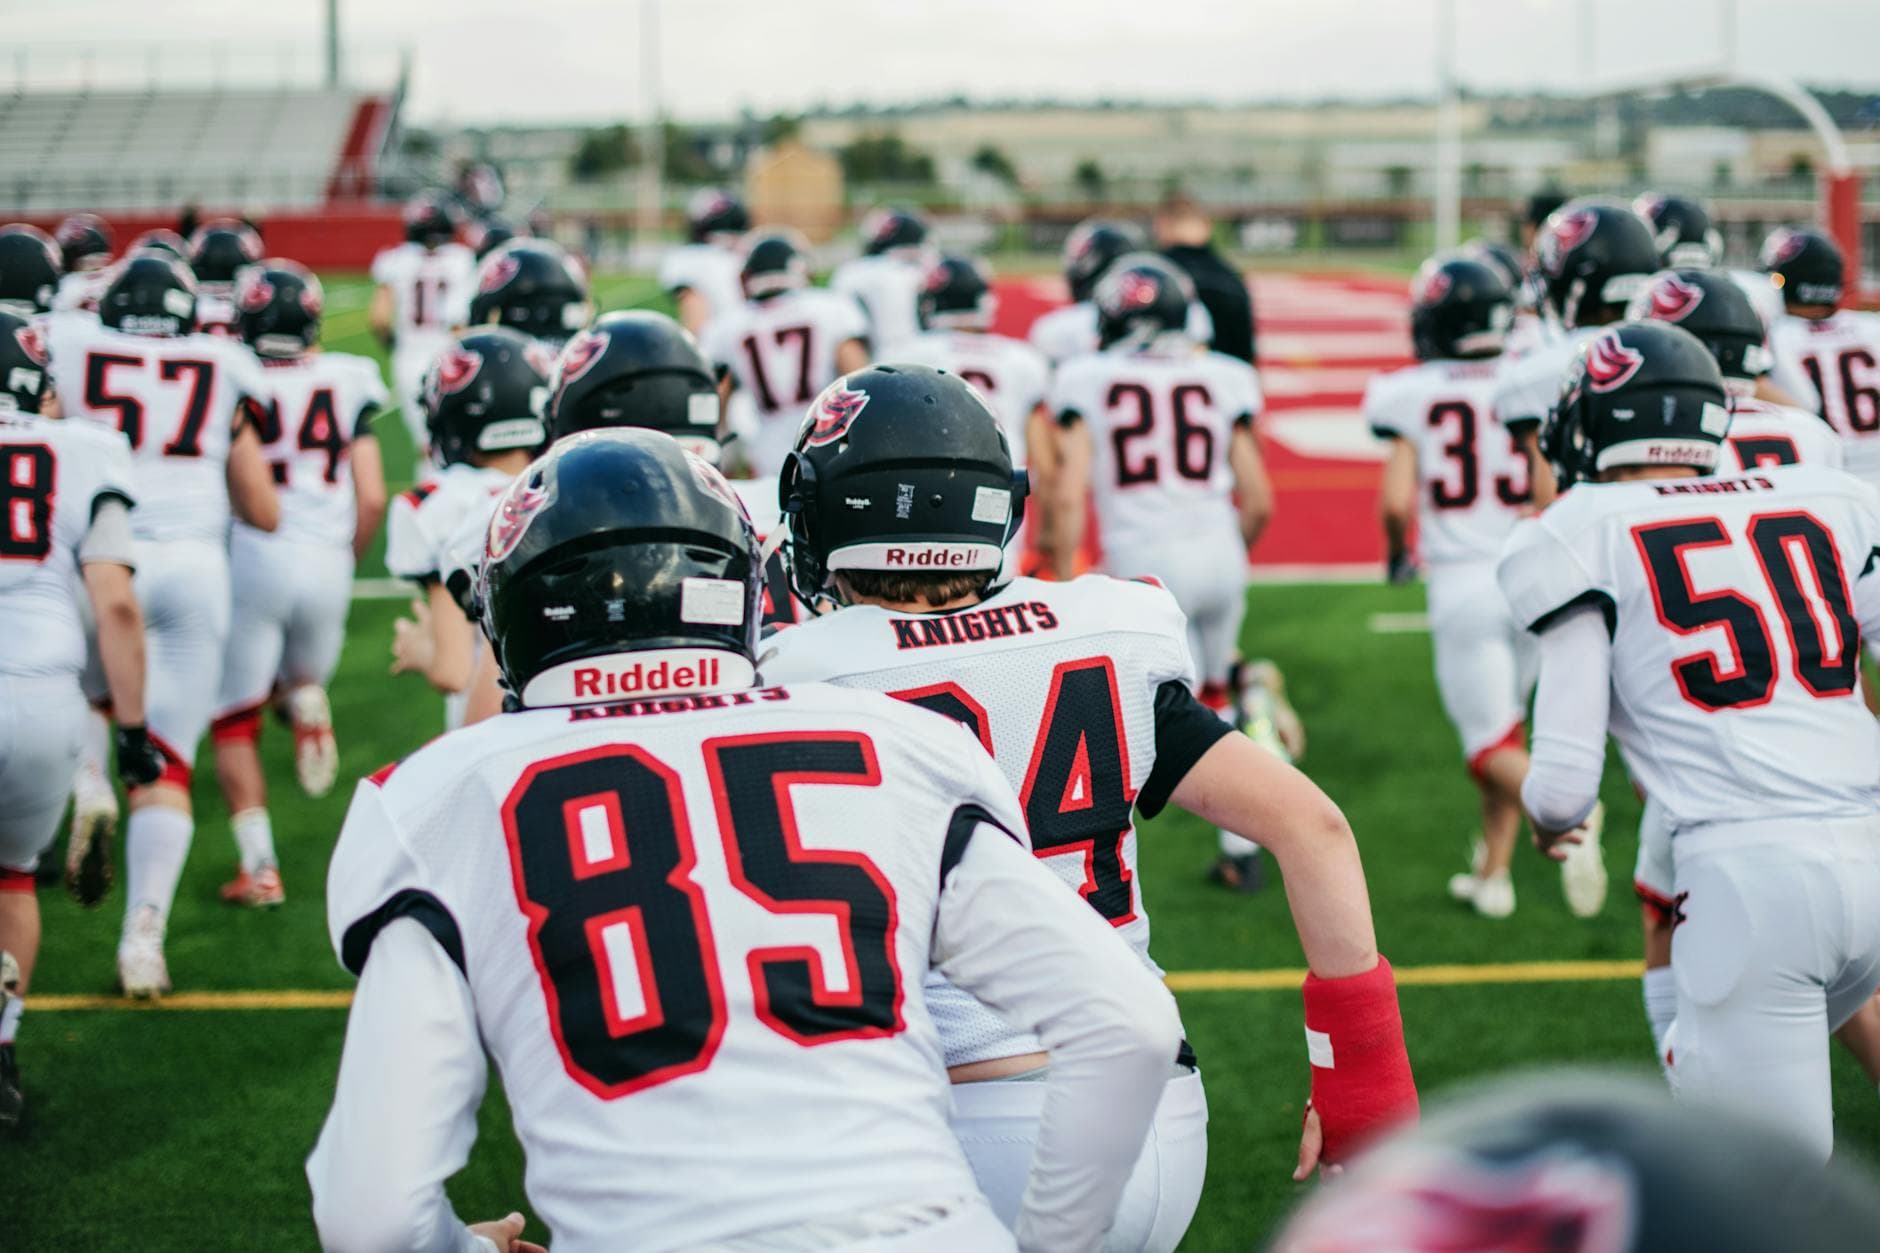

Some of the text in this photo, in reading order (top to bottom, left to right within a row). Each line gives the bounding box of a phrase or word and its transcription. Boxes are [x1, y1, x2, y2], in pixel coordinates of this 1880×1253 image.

[84, 350, 214, 457] 57
[742, 325, 814, 415] 17
[1801, 347, 1880, 434] 16
[1105, 382, 1218, 488] 26
[0, 442, 57, 562] 8
[886, 548, 979, 567] Riddell
[889, 600, 1060, 650] KNIGHTS
[1630, 510, 1862, 712] 50
[573, 657, 719, 698] Riddell
[500, 730, 907, 1102] 85
